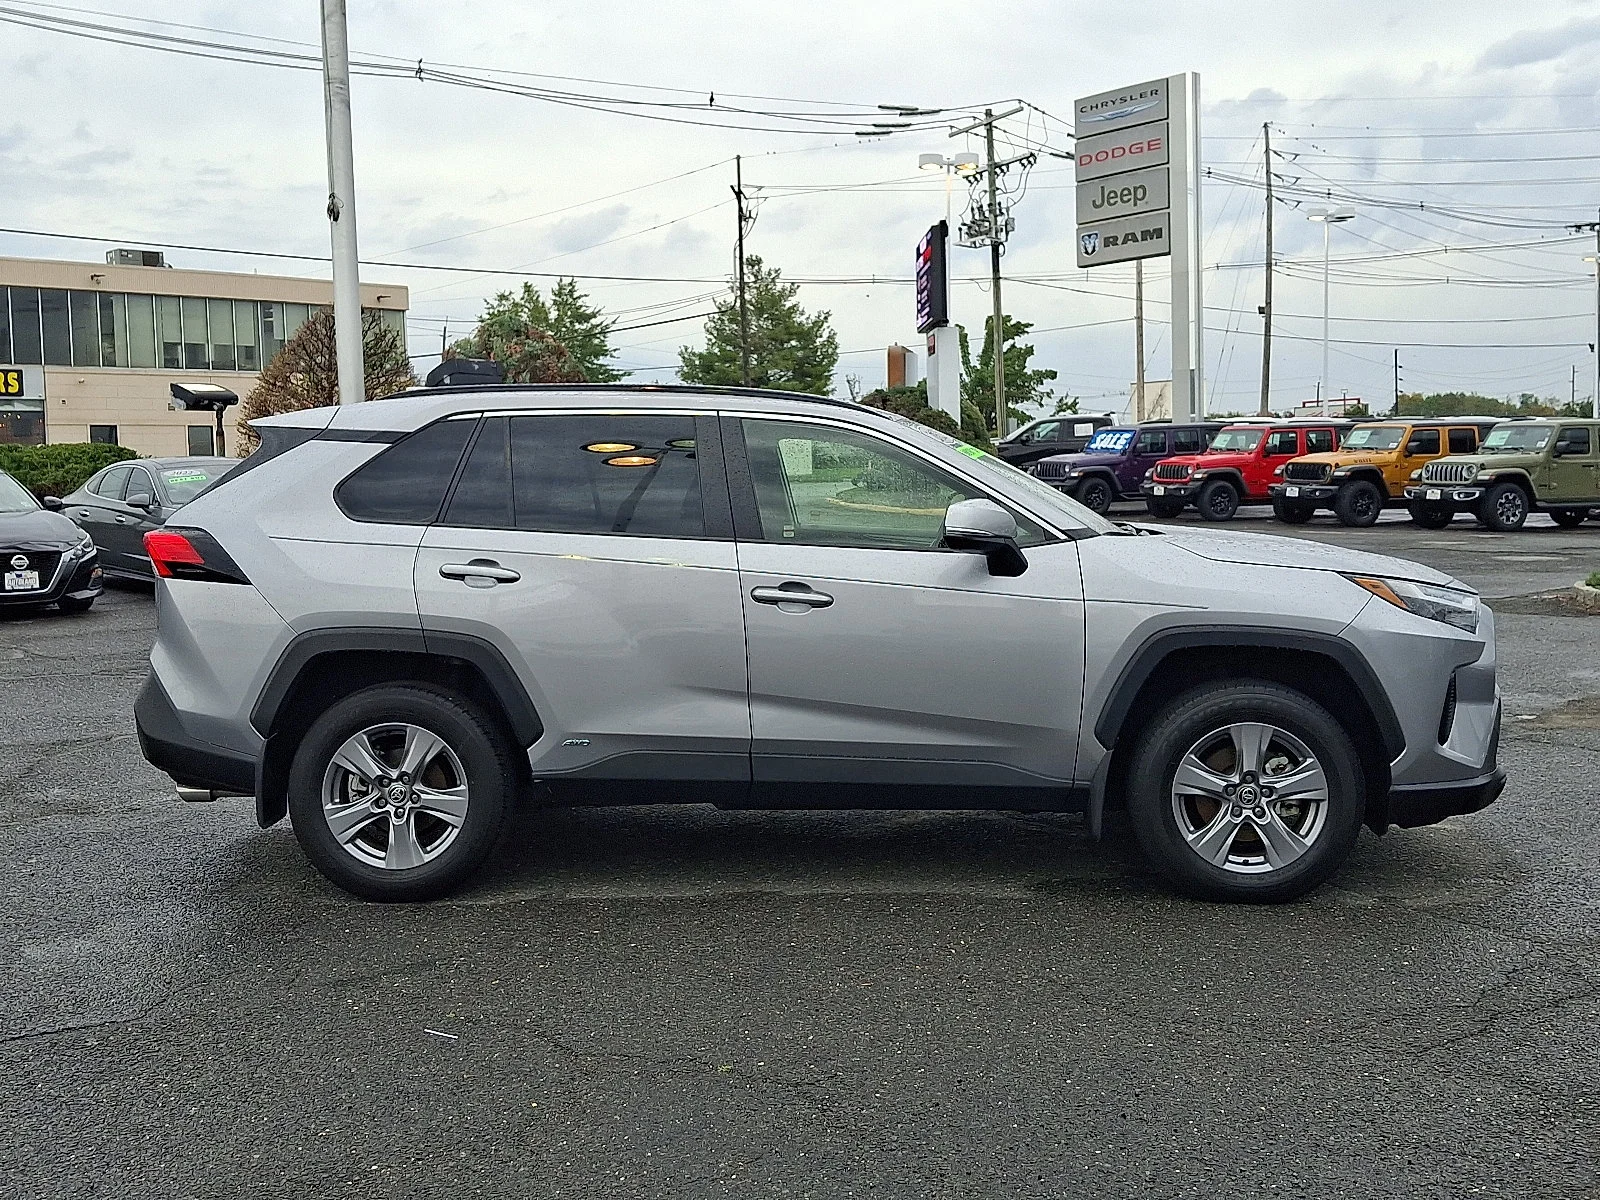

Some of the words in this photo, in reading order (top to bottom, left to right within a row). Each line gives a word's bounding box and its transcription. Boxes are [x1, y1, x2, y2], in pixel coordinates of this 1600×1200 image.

[1080, 89, 1159, 113] CHRYSLER
[1079, 138, 1162, 166] DODGE
[1092, 184, 1147, 209] Jeep
[1103, 227, 1163, 248] RAM
[1090, 433, 1131, 450] SALE
